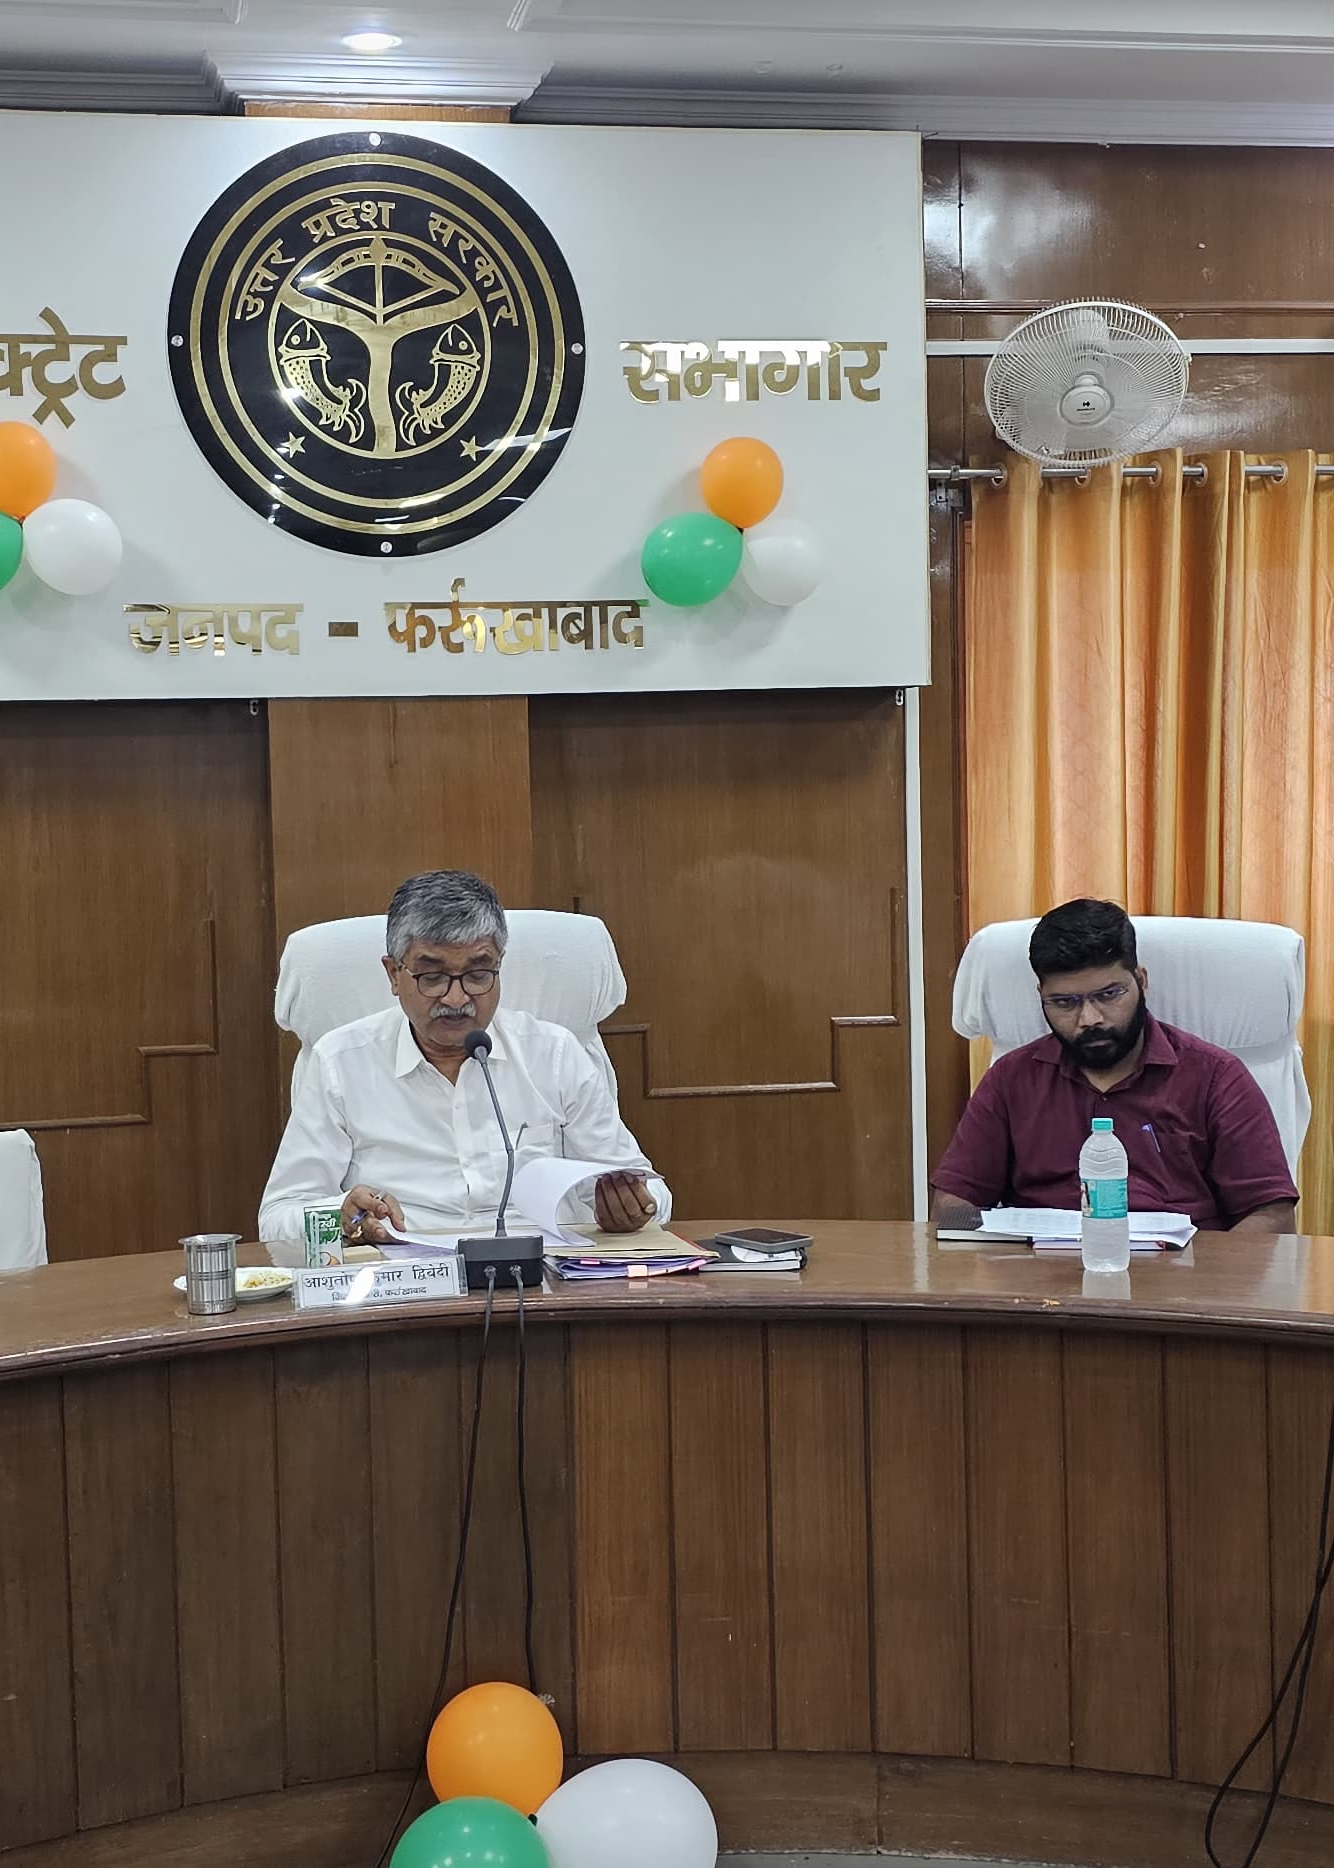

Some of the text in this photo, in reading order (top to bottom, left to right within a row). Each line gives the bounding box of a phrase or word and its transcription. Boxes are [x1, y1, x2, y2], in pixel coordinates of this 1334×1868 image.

[234, 198, 519, 327] उत्तर प्रदेश सरकार
[619, 339, 888, 403] सभागार
[123, 601, 304, 656] जनपद
[412, 1262, 450, 1281] द्विवेदी
